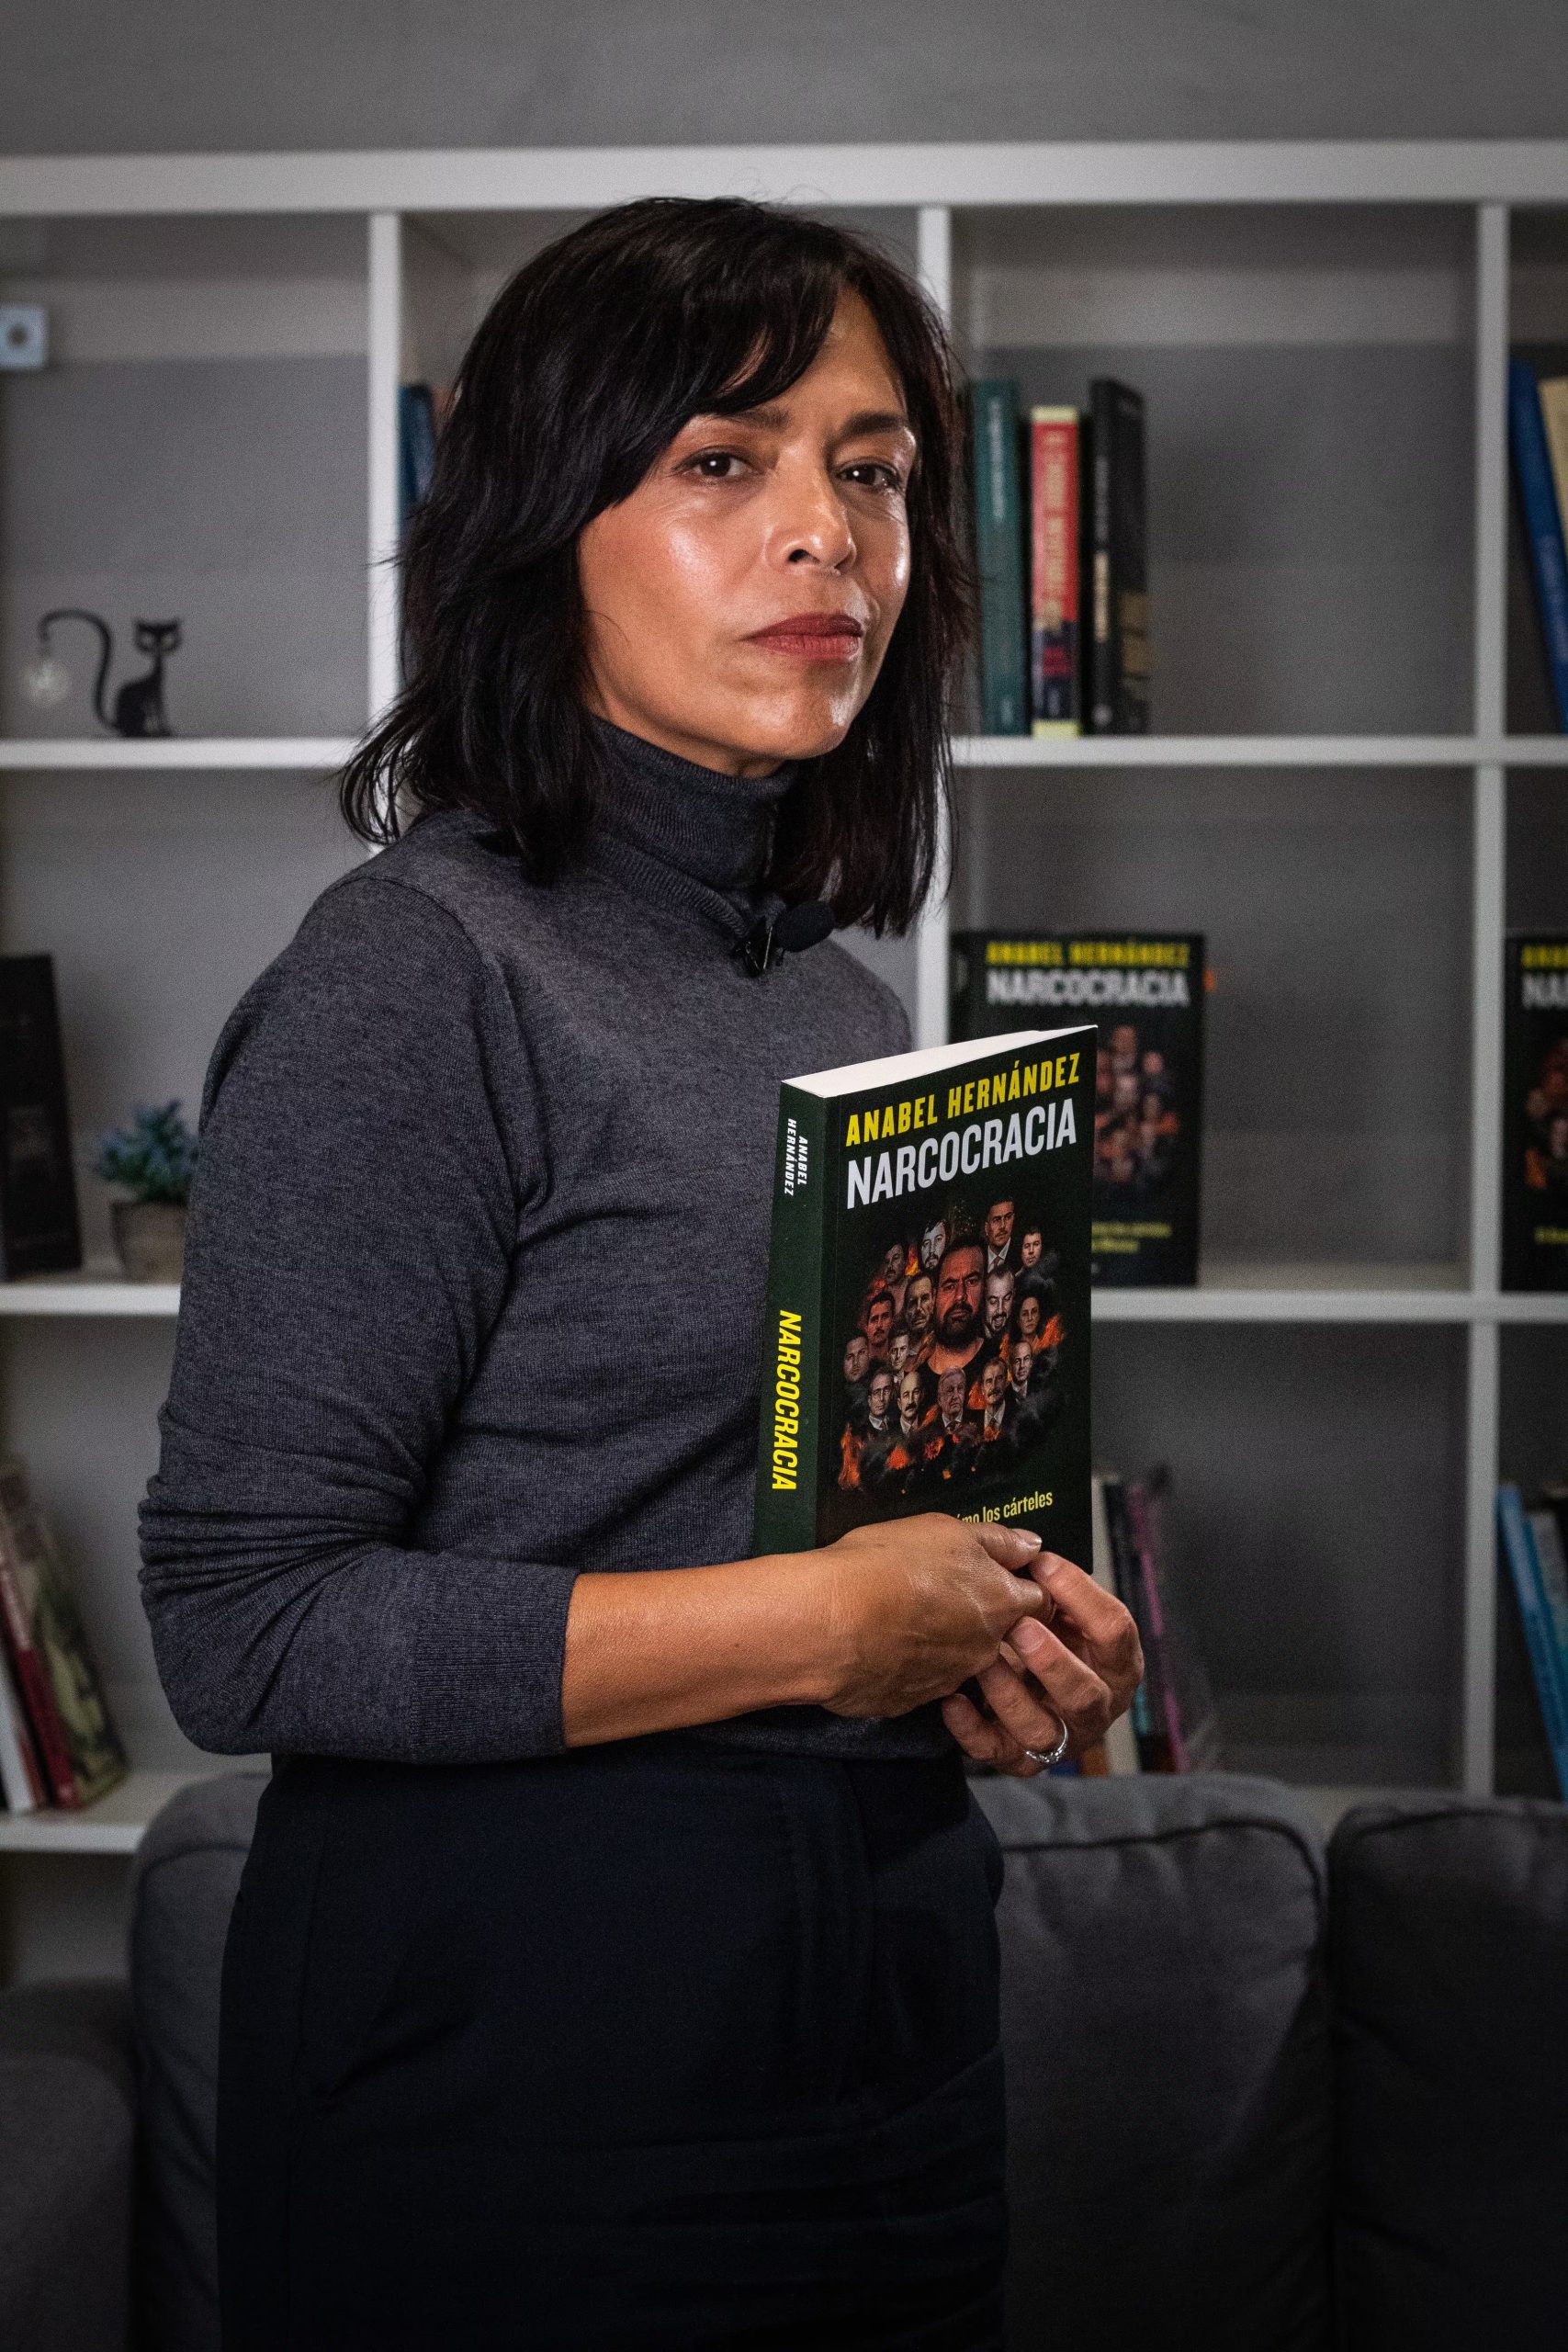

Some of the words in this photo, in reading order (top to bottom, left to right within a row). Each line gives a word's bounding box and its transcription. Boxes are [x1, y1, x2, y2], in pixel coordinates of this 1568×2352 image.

[845, 1094, 938, 1148] ANABEL
[947, 1052, 1080, 1119] HERNÁNDEZ
[784, 1118, 797, 1196] HERNÁNDEZ
[797, 1136, 808, 1185] ANABEL
[847, 1098, 1077, 1210] NARCOCRACIA
[772, 1309, 802, 1490] NARCOCRACIA
[982, 1506, 1000, 1523] los
[1003, 1491, 1054, 1519] cárteles
